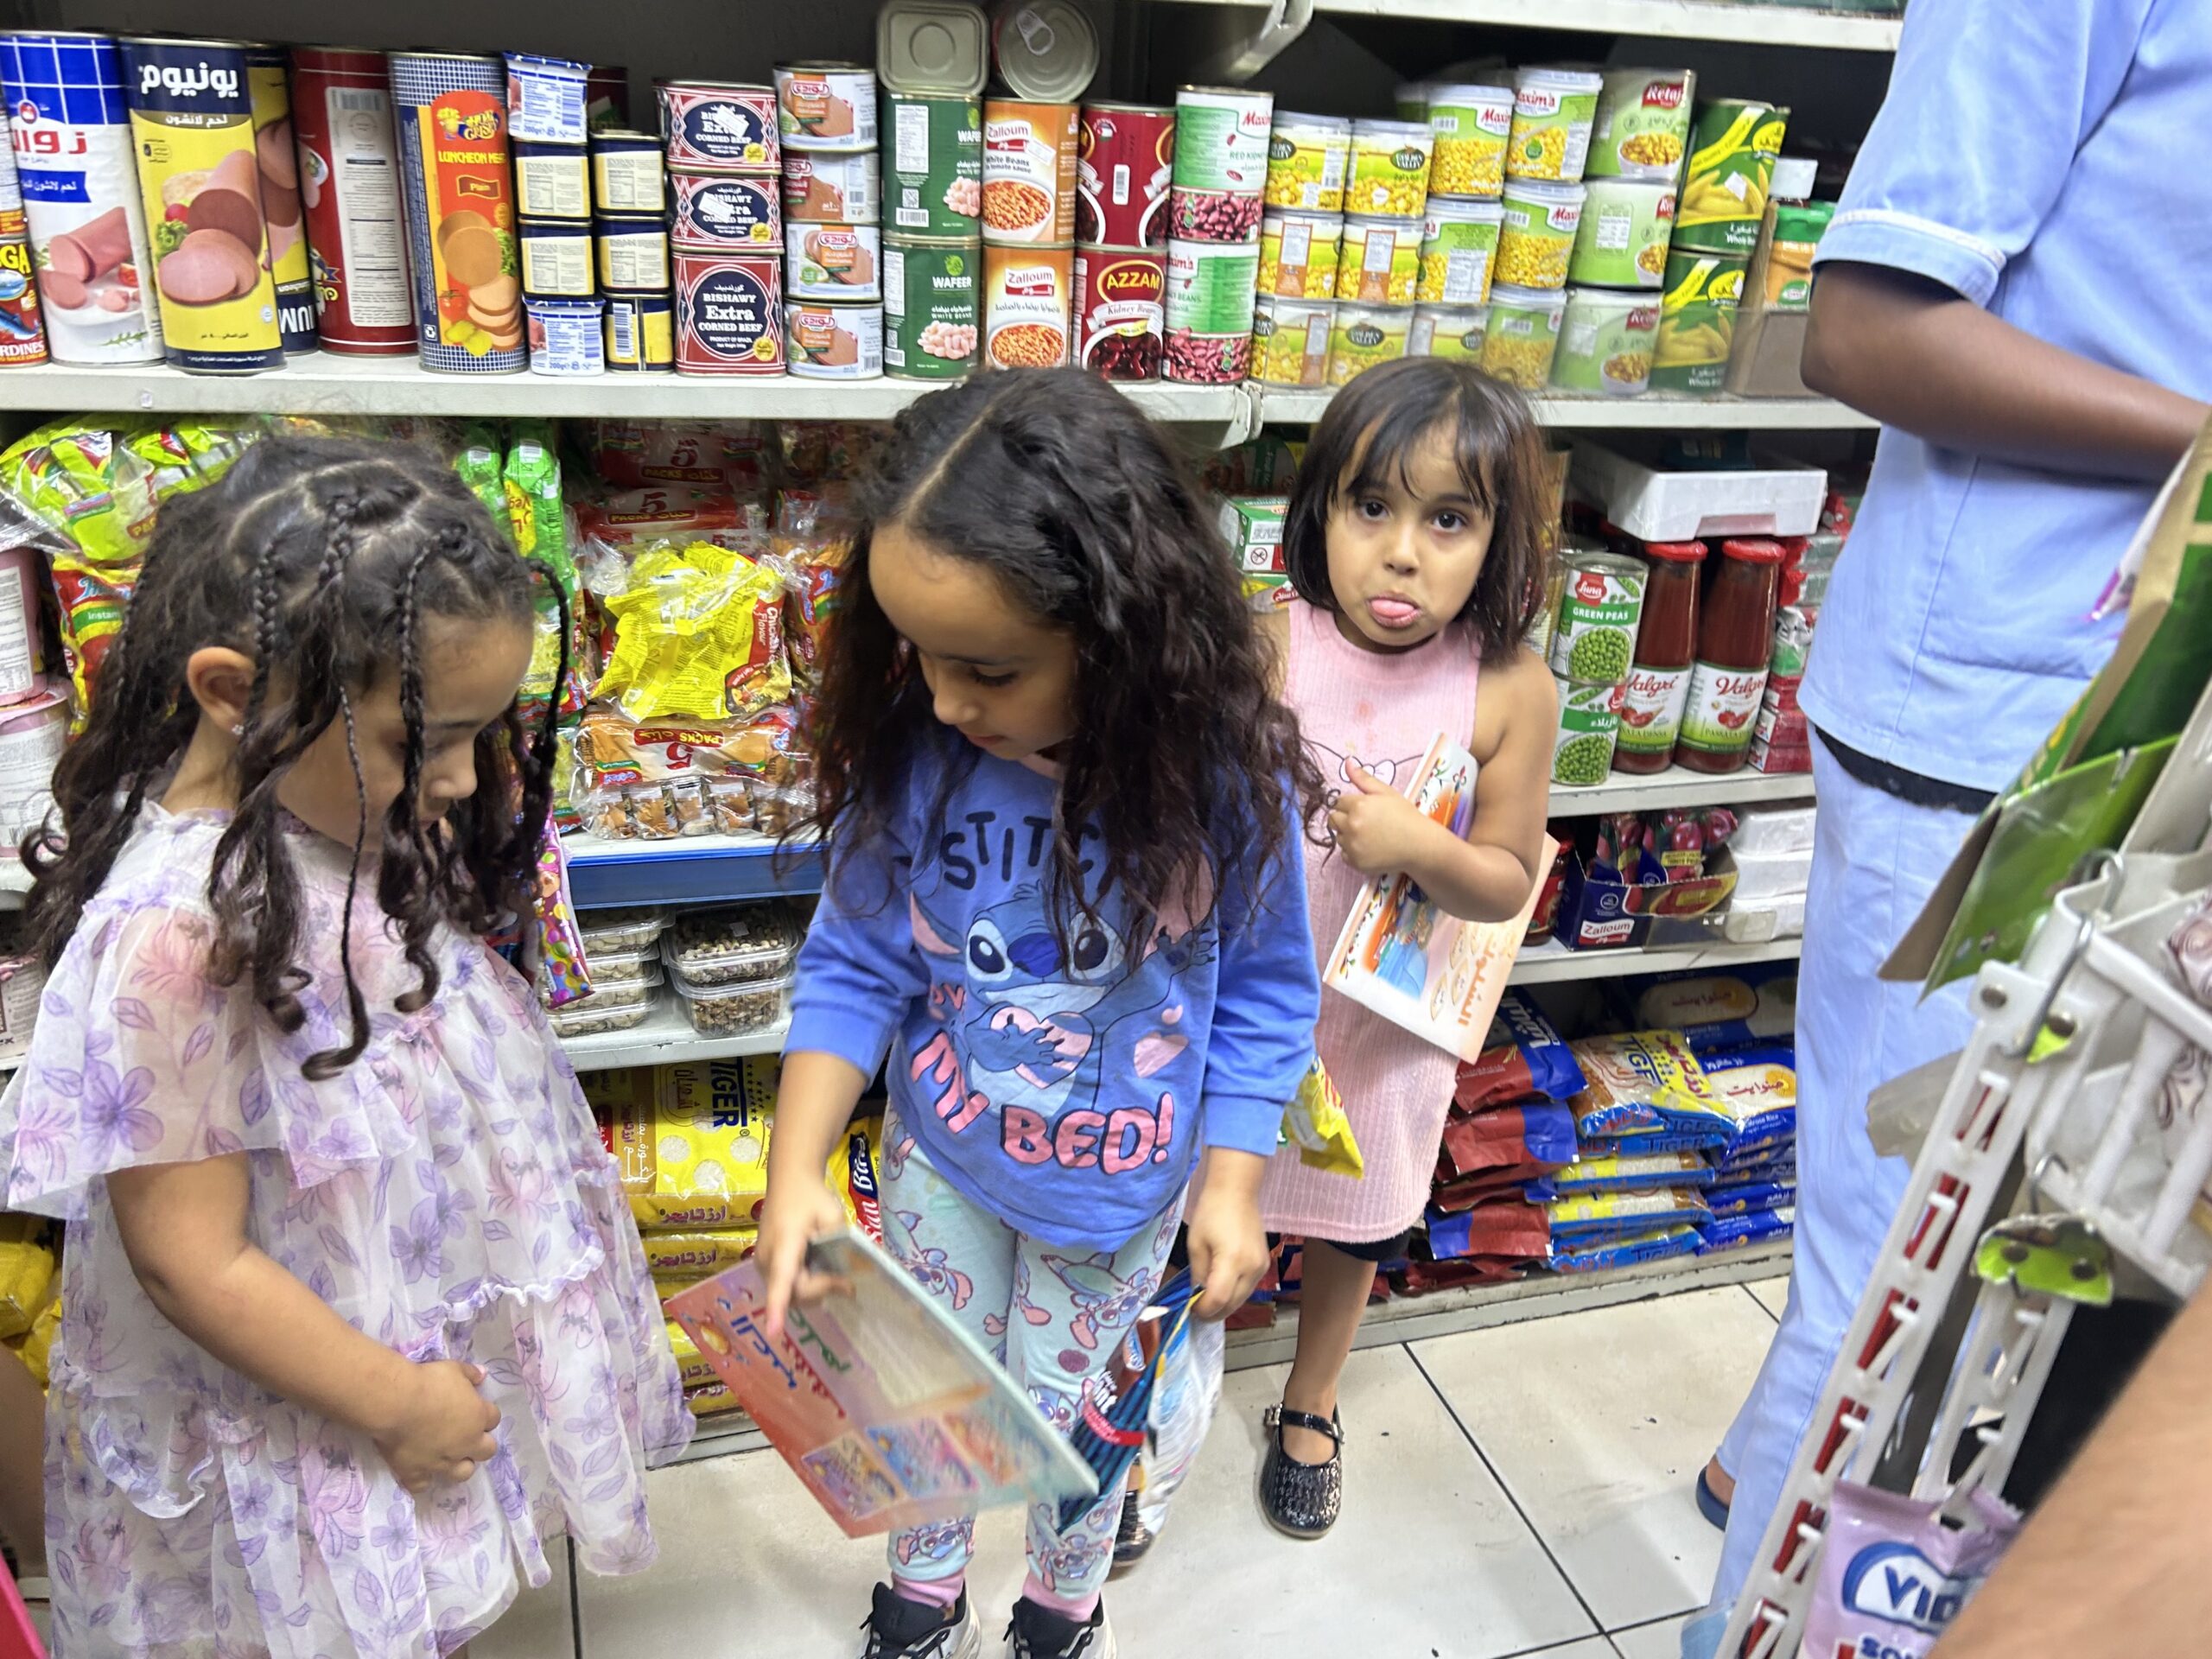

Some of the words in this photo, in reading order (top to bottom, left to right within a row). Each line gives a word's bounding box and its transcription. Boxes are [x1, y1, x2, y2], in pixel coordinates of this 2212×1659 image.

[141, 61, 239, 99] يونيوم
[988, 125, 1028, 138] Zalloum
[438, 150, 488, 164] LUNCHEON
[0, 244, 32, 274] GA
[932, 276, 972, 289] WAFEER
[1008, 271, 1052, 285] Zalloum
[1107, 272, 1160, 290] AZZAM
[702, 293, 757, 303] BISHAWY
[705, 304, 756, 321] Extra
[1108, 303, 1135, 317] Kidney
[698, 321, 737, 332] CORNED
[739, 323, 763, 333] BEEF
[0, 341, 45, 357] RDINES
[671, 438, 699, 467] 5
[639, 491, 668, 513] 5
[1579, 582, 1603, 597] Luna
[1573, 607, 1604, 620] GREEN
[1605, 609, 1629, 621] PEAS
[679, 732, 720, 744] PACKS
[666, 742, 693, 770] 5
[1585, 921, 1630, 936] Zalloum
[710, 1056, 748, 1128] TIGER
[1000, 1091, 1175, 1175] BED!
